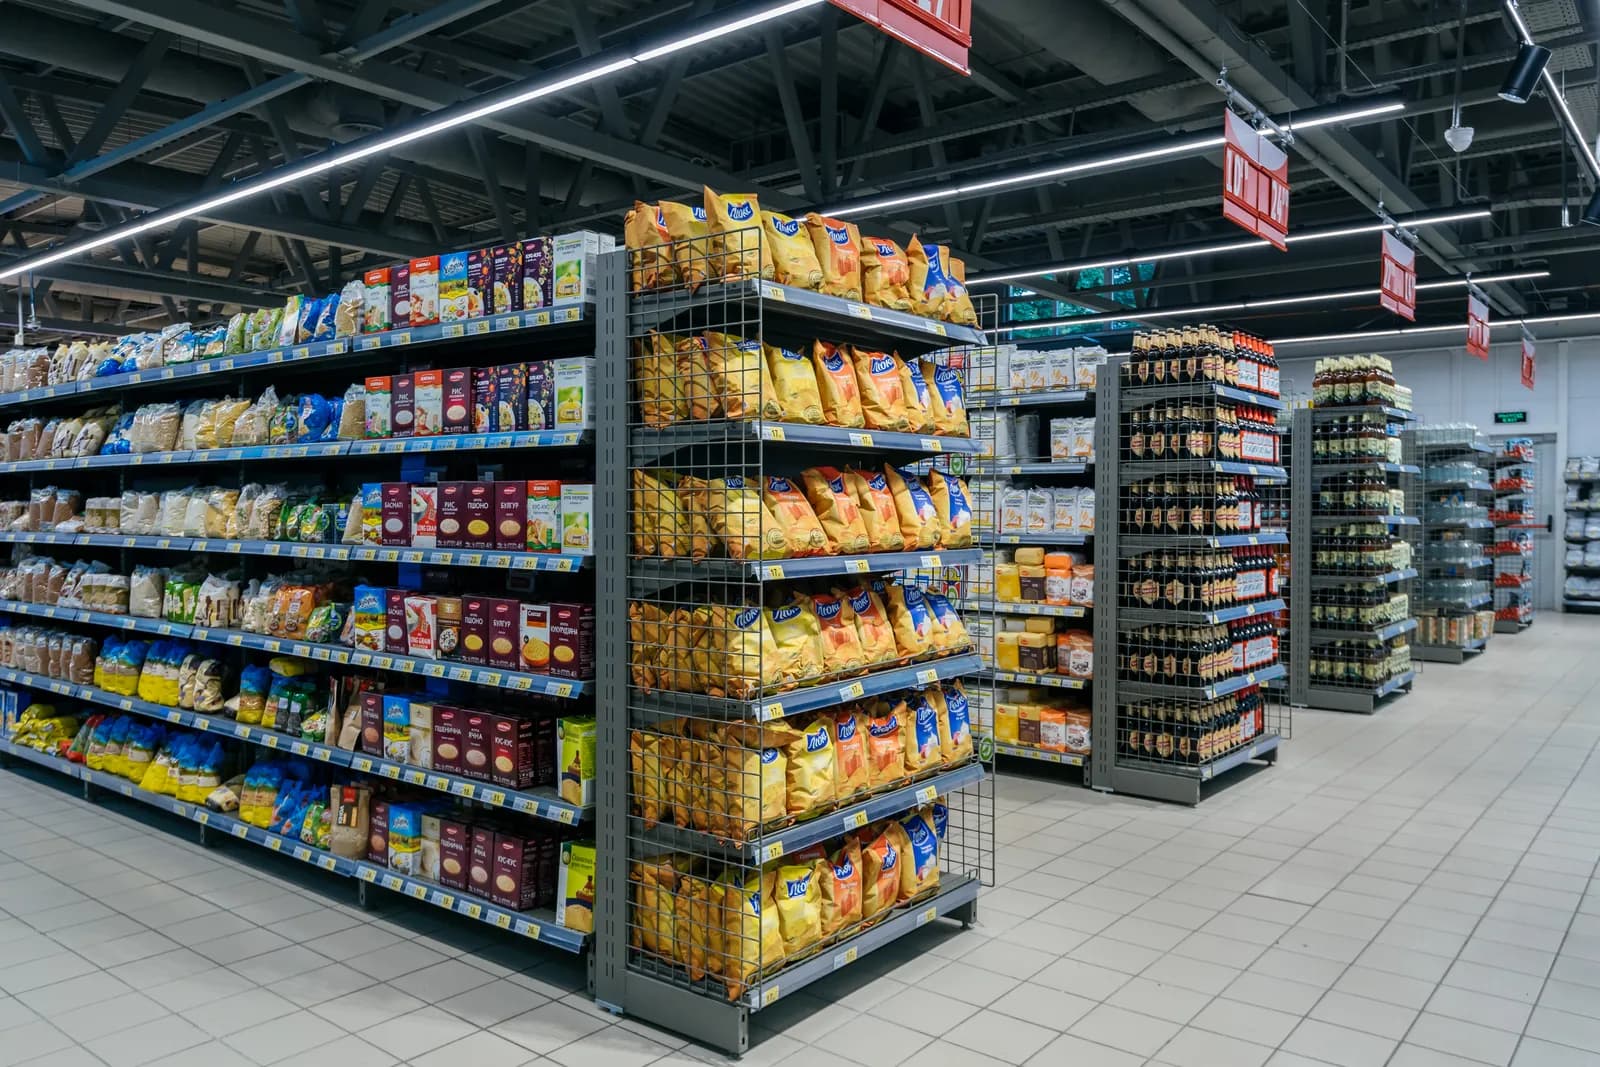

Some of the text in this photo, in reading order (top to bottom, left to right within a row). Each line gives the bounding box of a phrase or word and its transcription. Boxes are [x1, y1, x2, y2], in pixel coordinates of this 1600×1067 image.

[451, 387, 462, 395] РИС
[444, 501, 455, 509] РИС
[464, 616, 484, 625] ПШОНО
